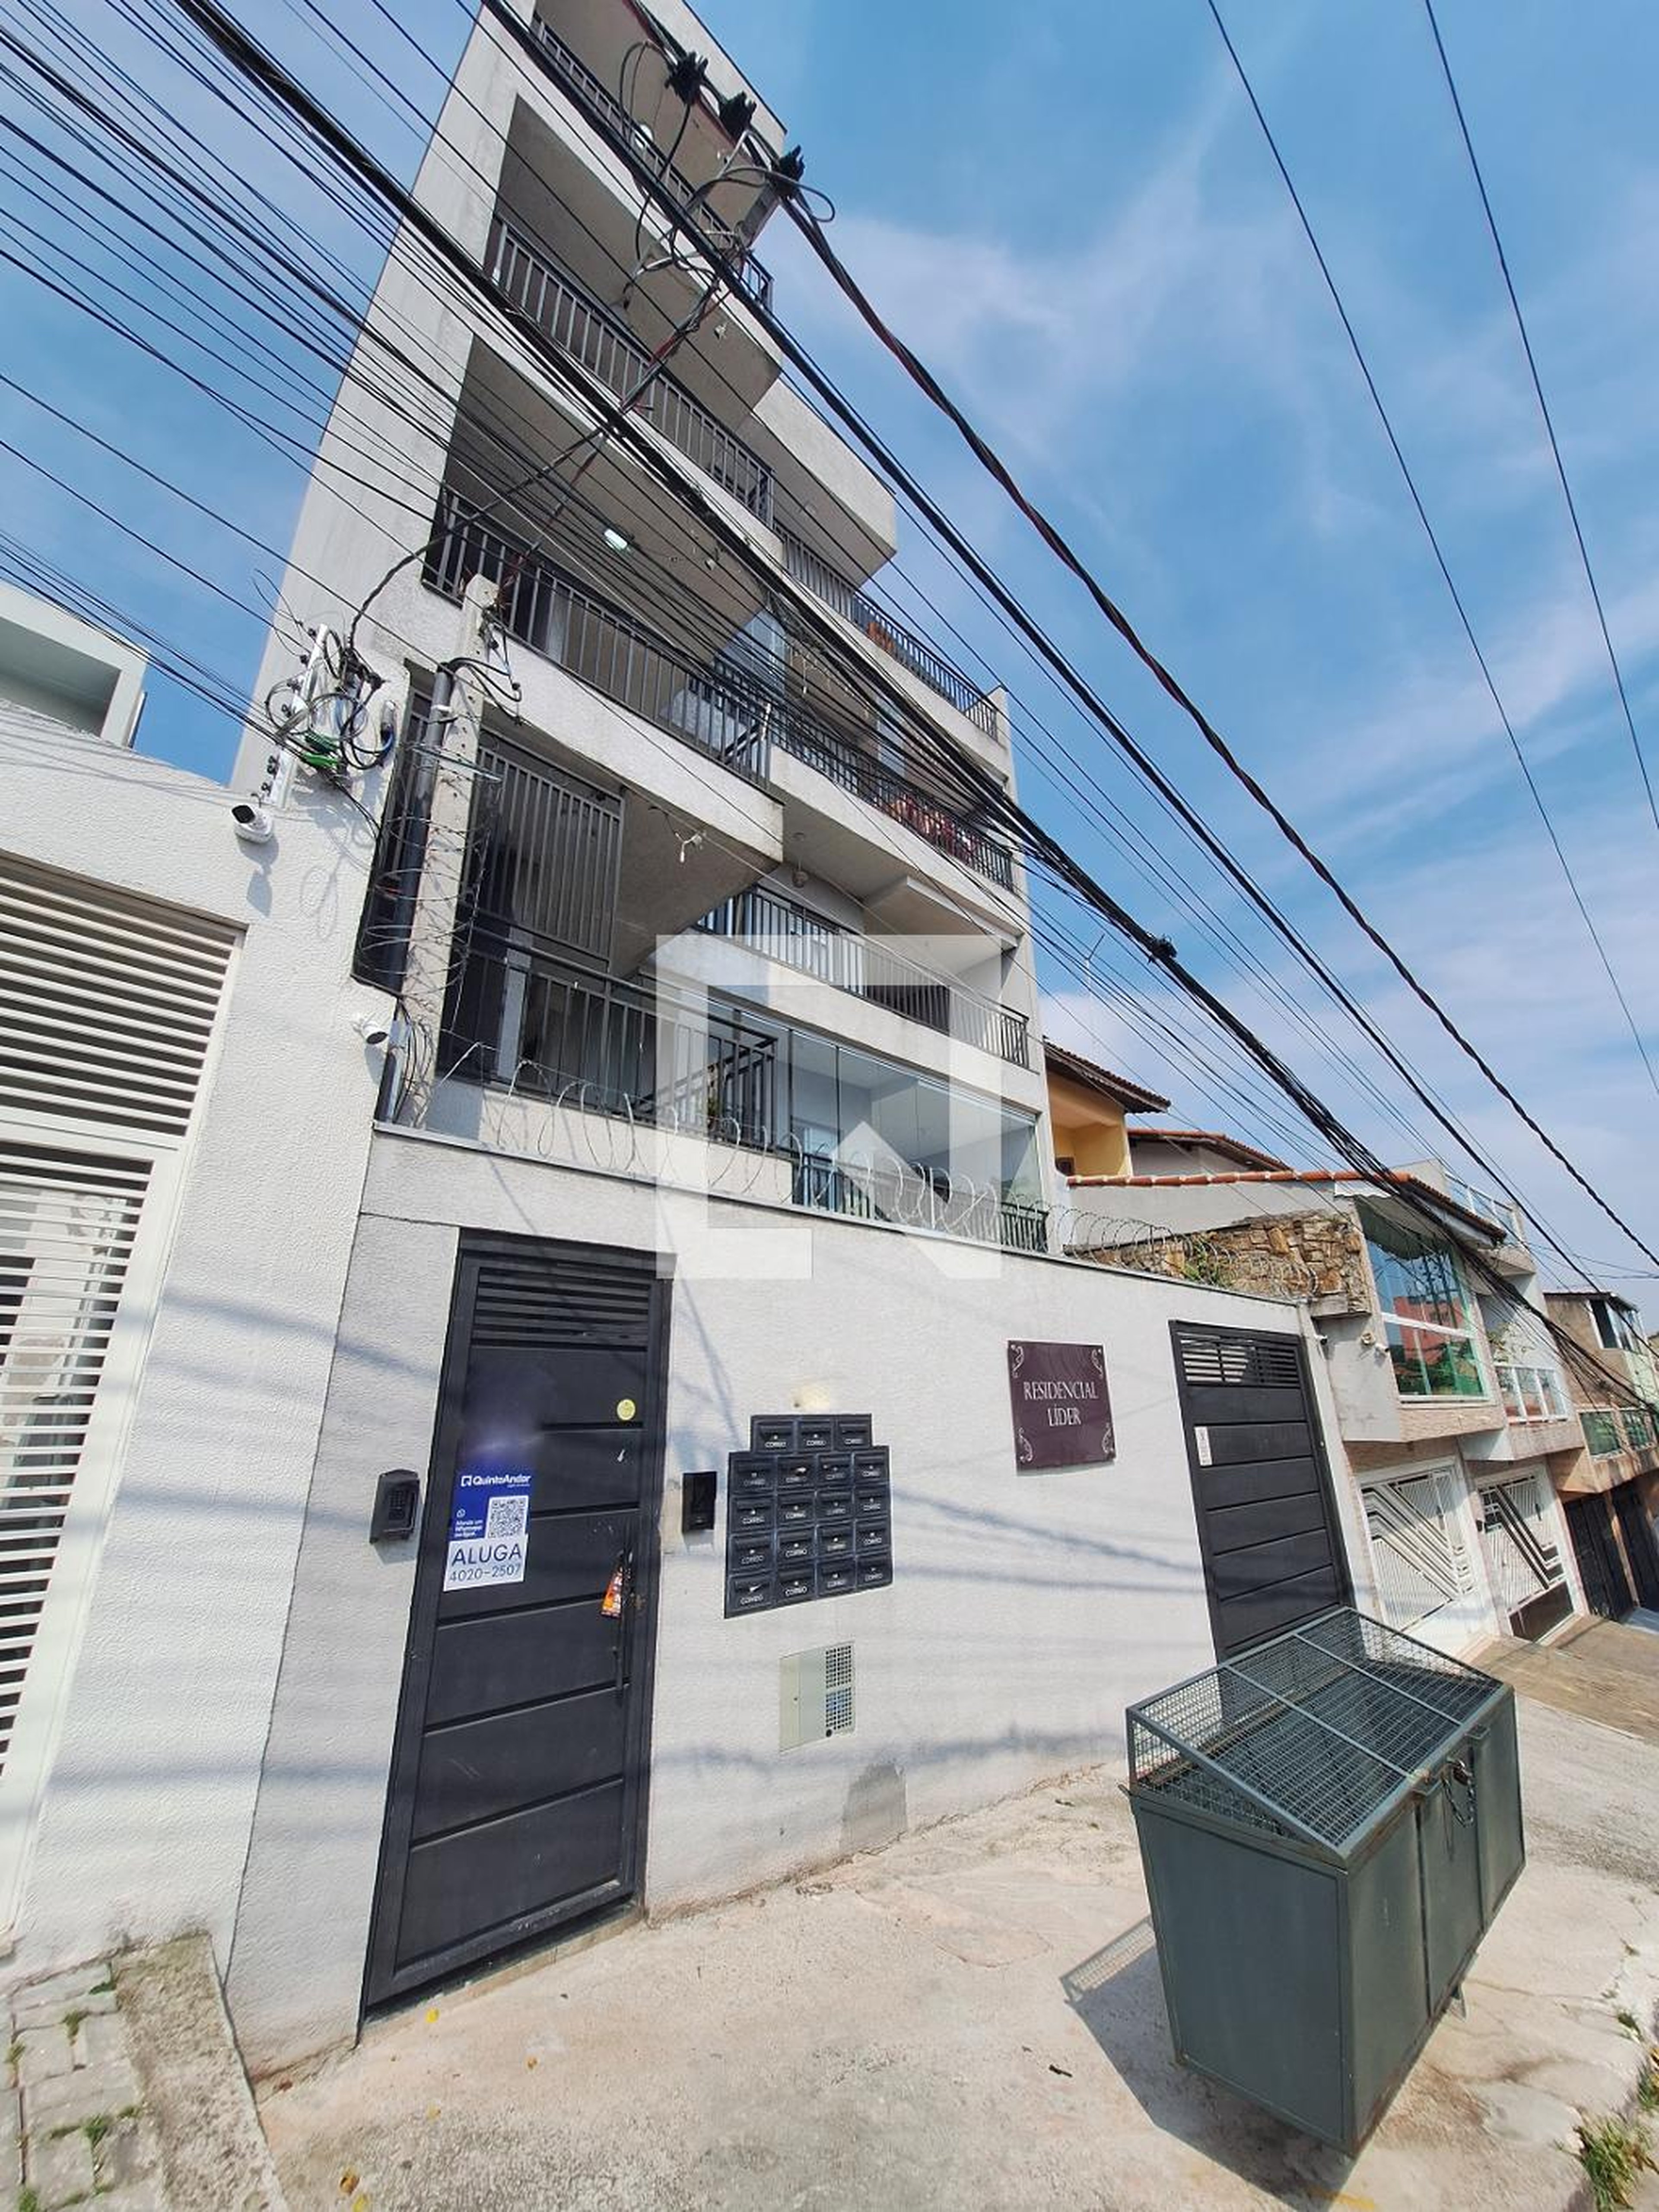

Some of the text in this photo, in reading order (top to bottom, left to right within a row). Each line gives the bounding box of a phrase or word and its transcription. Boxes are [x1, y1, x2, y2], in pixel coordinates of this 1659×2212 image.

[1023, 1381, 1099, 1400] RESIDENCIAL
[451, 1544, 521, 1566] ALUGA
[450, 1564, 521, 1582] 4020-2507
